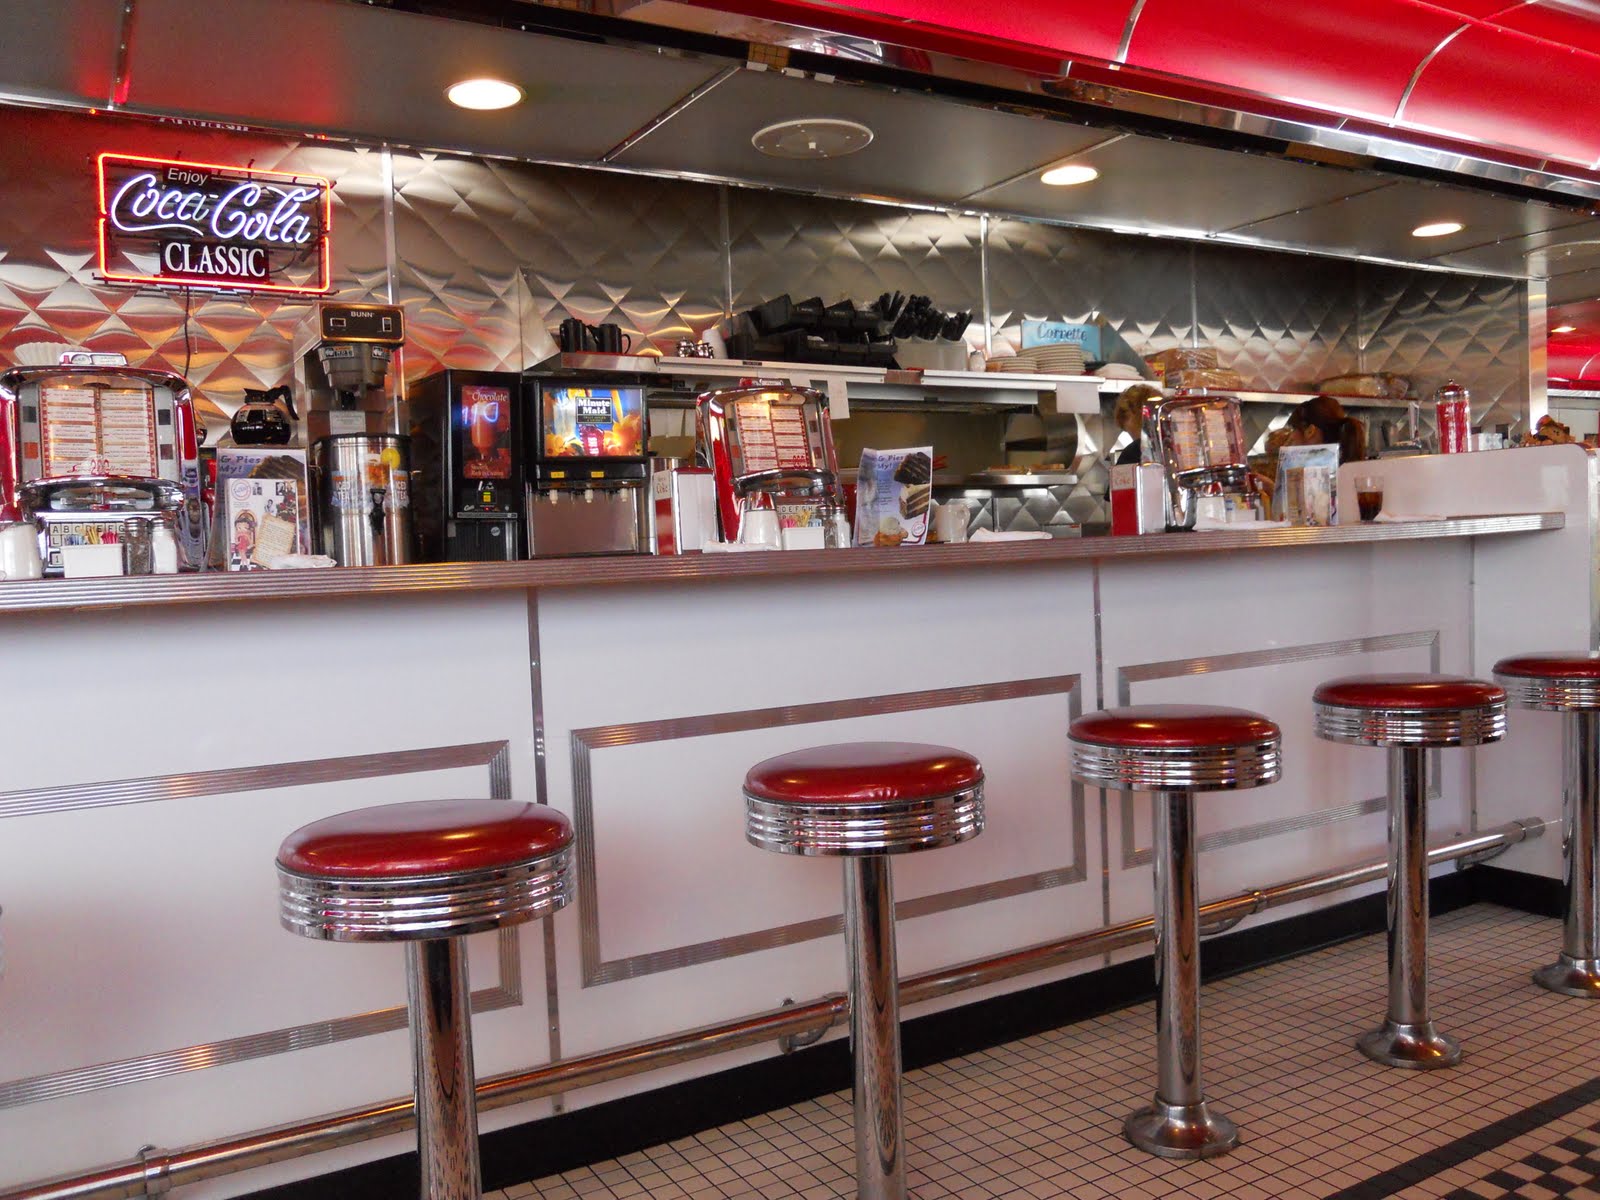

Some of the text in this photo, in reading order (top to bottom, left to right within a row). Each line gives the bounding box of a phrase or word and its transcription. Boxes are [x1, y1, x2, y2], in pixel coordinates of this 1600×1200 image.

[167, 167, 209, 185] Enjoy
[110, 173, 321, 244] Coca-Cola
[164, 242, 266, 277] CLASSIC
[350, 310, 374, 318] BUNN
[1037, 322, 1088, 341] Corvette
[471, 389, 508, 402] Chocolate
[578, 398, 610, 407] Minute
[582, 406, 608, 414] Maid
[235, 455, 262, 464] Pies
[52, 525, 60, 534] A
[63, 525, 70, 533] B
[118, 524, 125, 533] G
[52, 537, 60, 545] L
